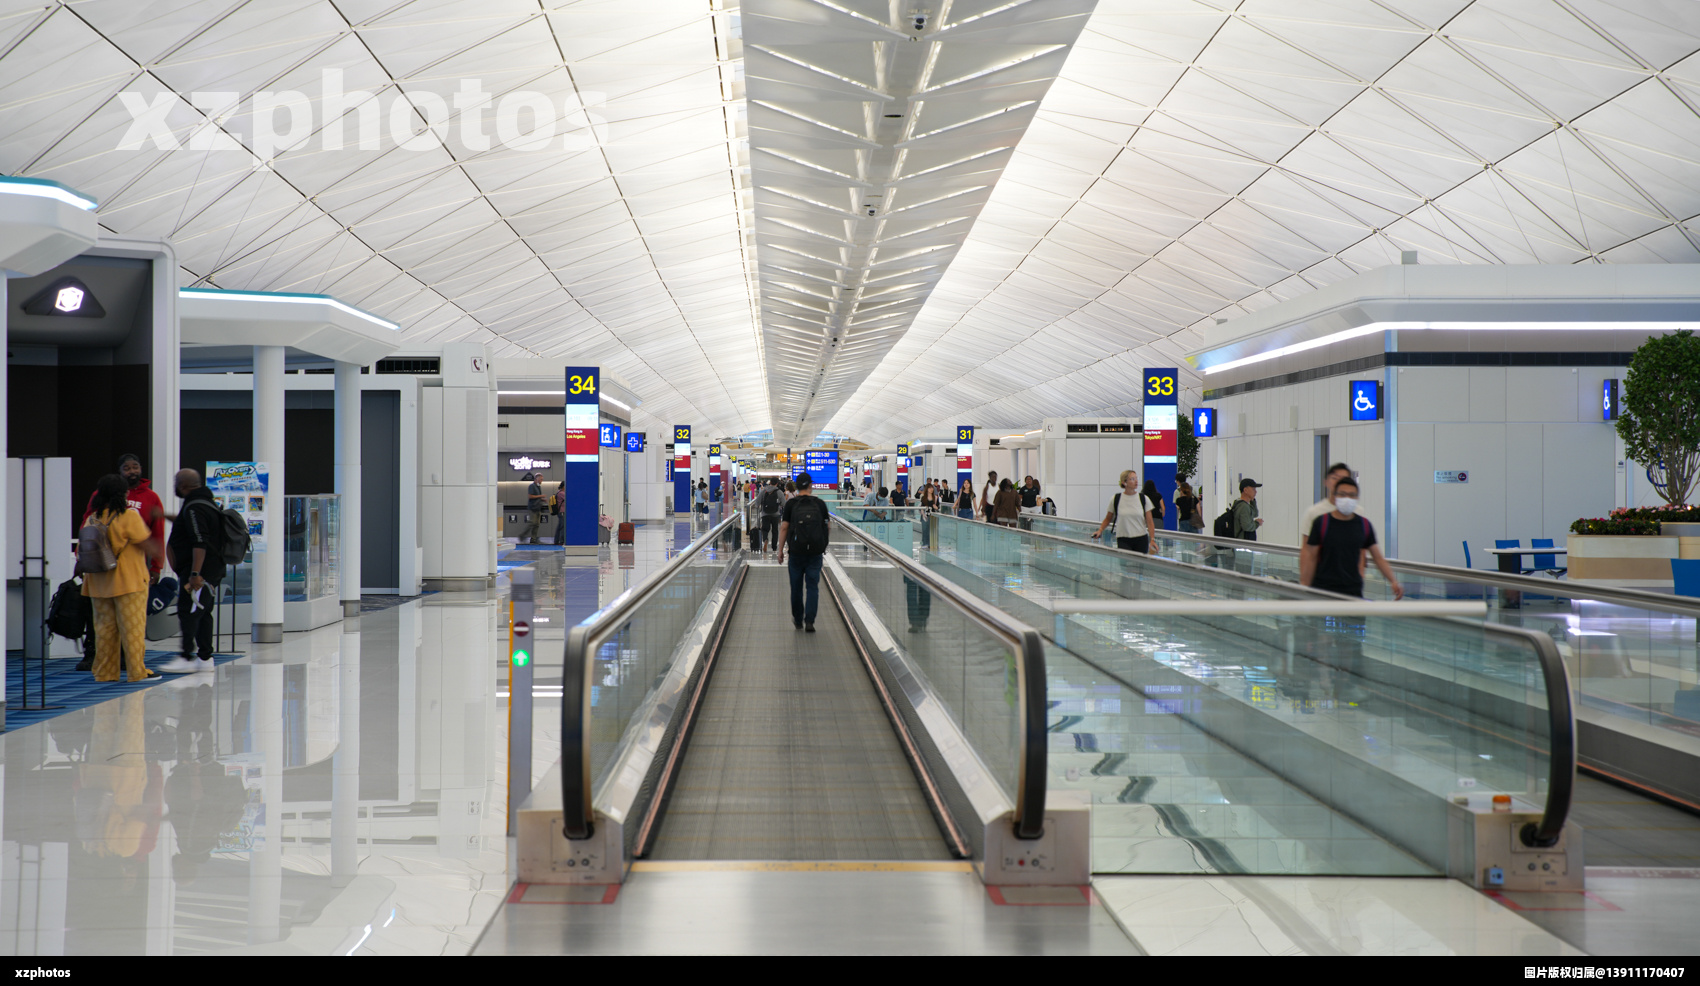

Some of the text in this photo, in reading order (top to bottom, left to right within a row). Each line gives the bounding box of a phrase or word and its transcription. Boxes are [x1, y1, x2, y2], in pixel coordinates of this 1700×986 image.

[569, 375, 596, 395] 34
[1147, 376, 1174, 396] 33
[676, 428, 690, 439] 32
[960, 429, 971, 440] 31
[710, 446, 720, 454] 30
